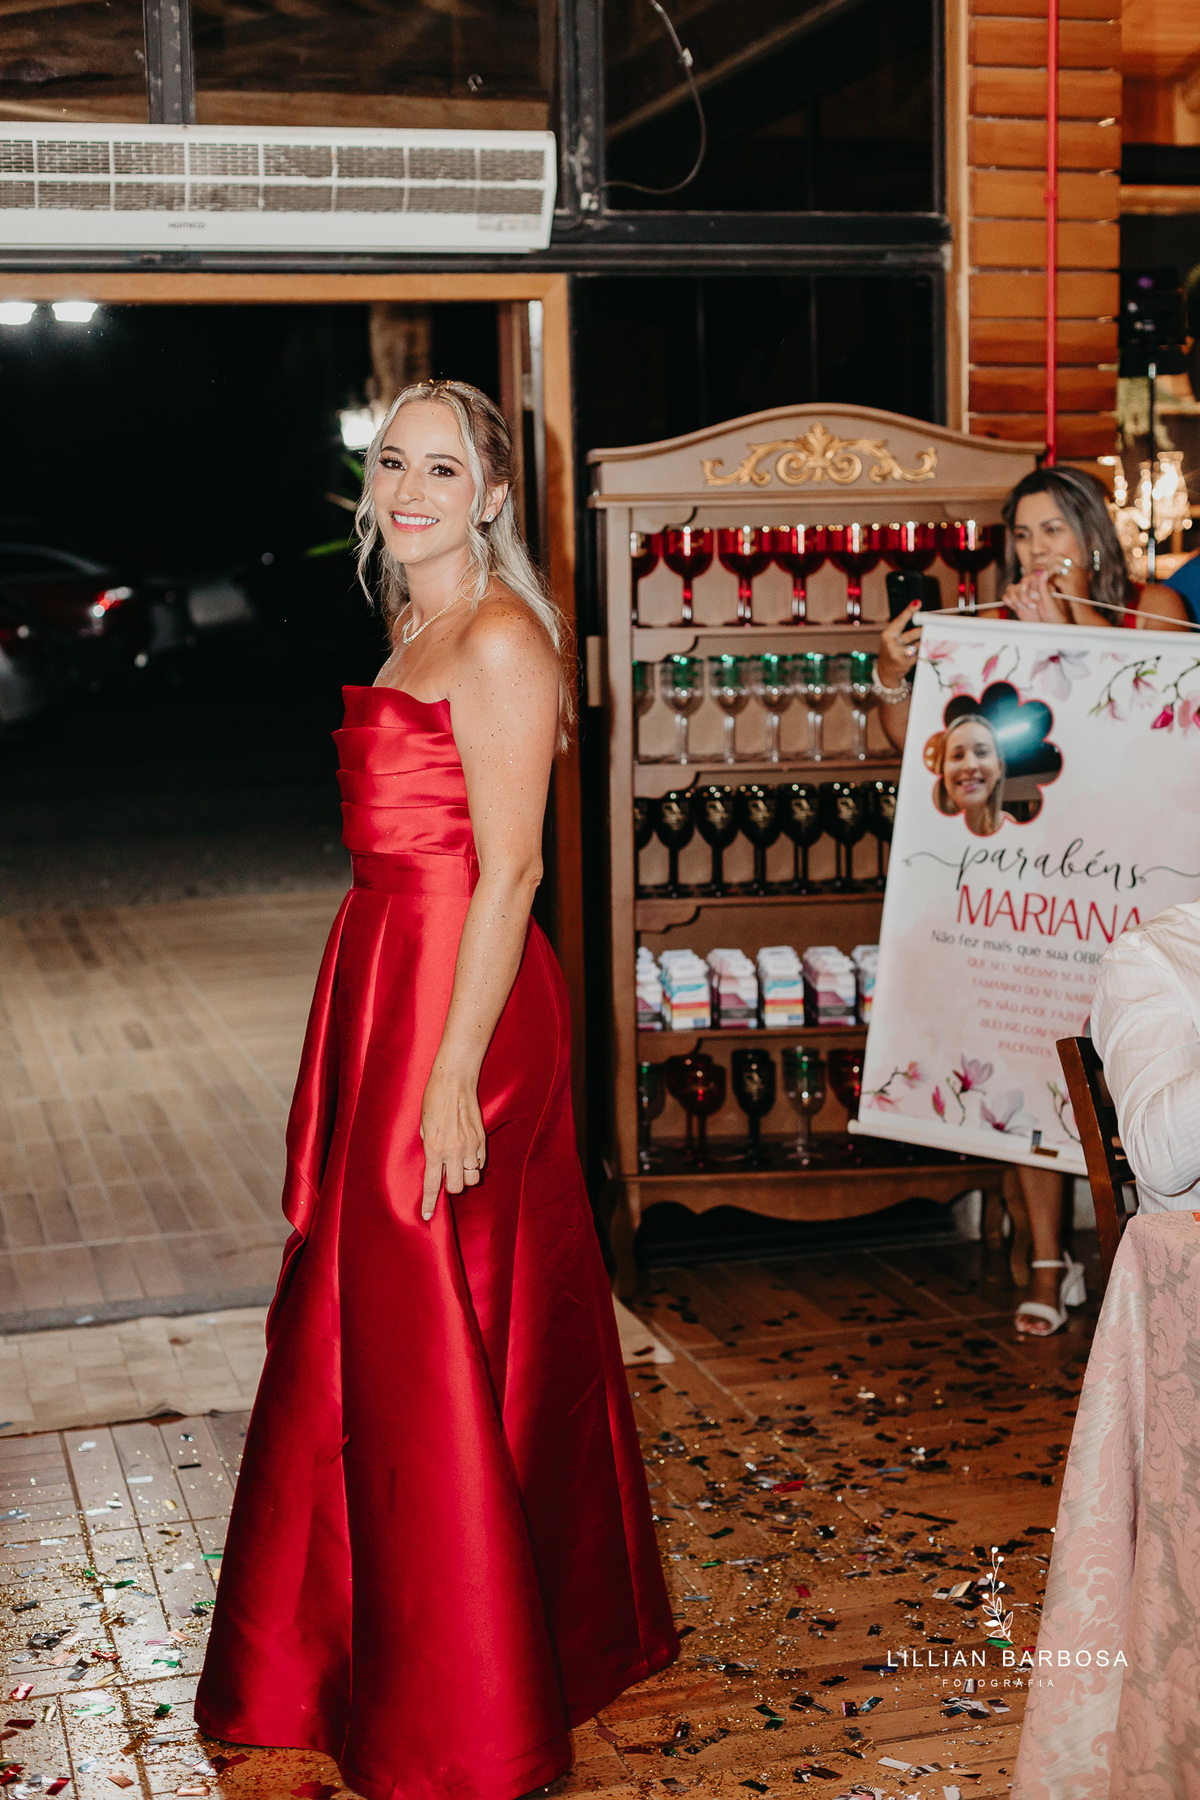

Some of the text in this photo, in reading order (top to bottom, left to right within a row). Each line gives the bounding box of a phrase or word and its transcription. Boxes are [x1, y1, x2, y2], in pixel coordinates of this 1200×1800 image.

[956, 838, 1146, 891] parabéns
[931, 930, 1101, 966] Não fez mais que sua OBR
